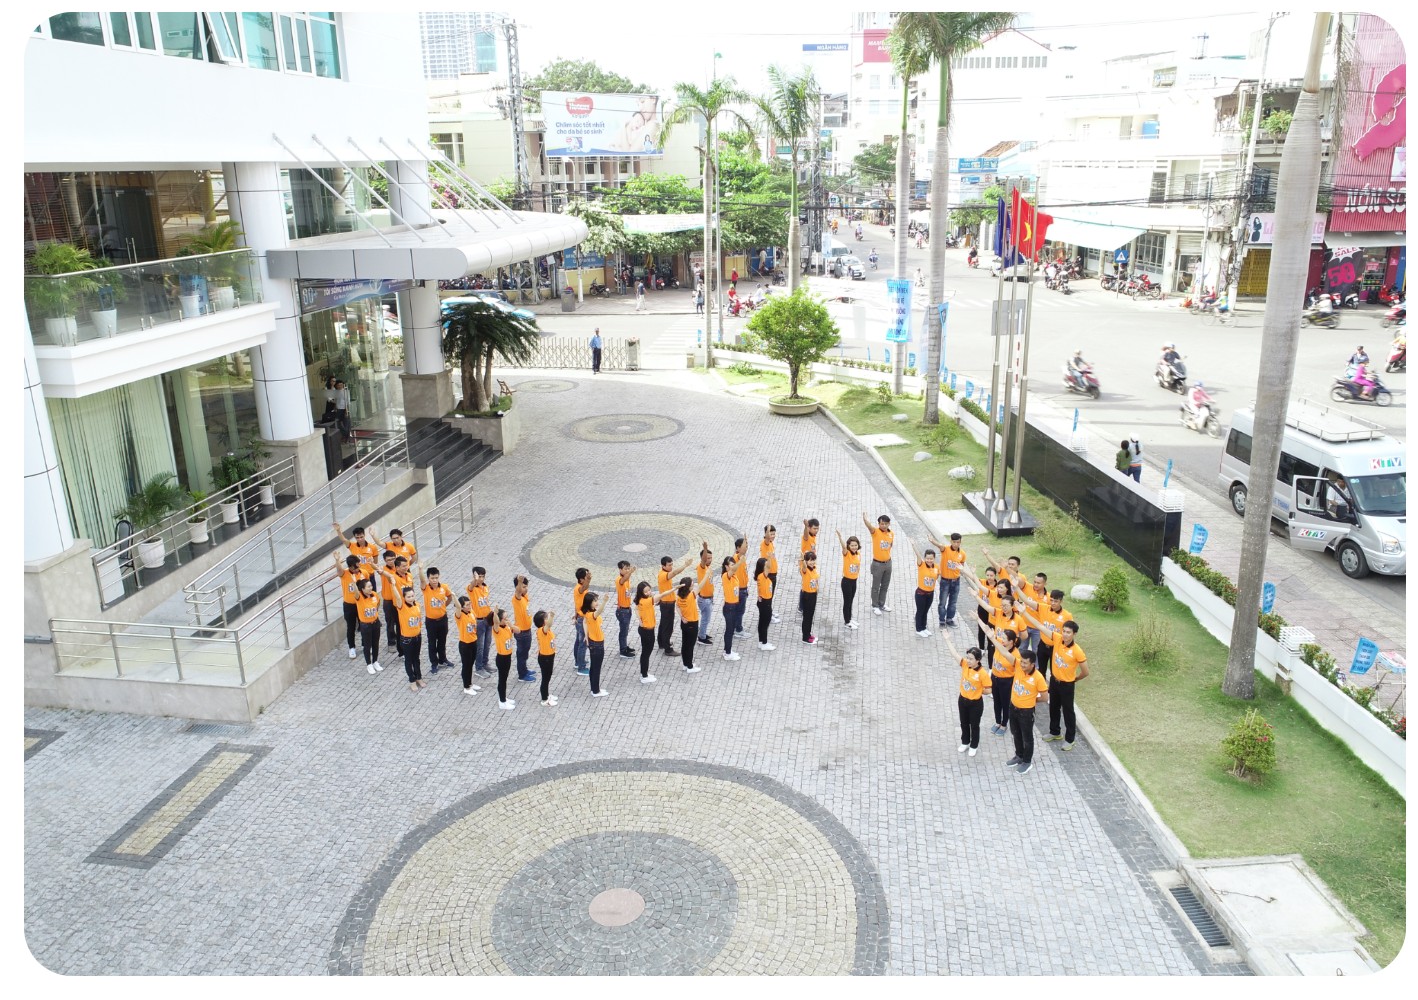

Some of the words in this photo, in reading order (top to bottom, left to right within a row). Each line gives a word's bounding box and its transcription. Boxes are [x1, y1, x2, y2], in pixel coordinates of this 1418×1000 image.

[1343, 183, 1382, 214] NÓN
[1334, 246, 1358, 258] SALE
[1327, 262, 1356, 288] 50
[1370, 456, 1402, 470] KTV
[1299, 528, 1326, 539] KTV
